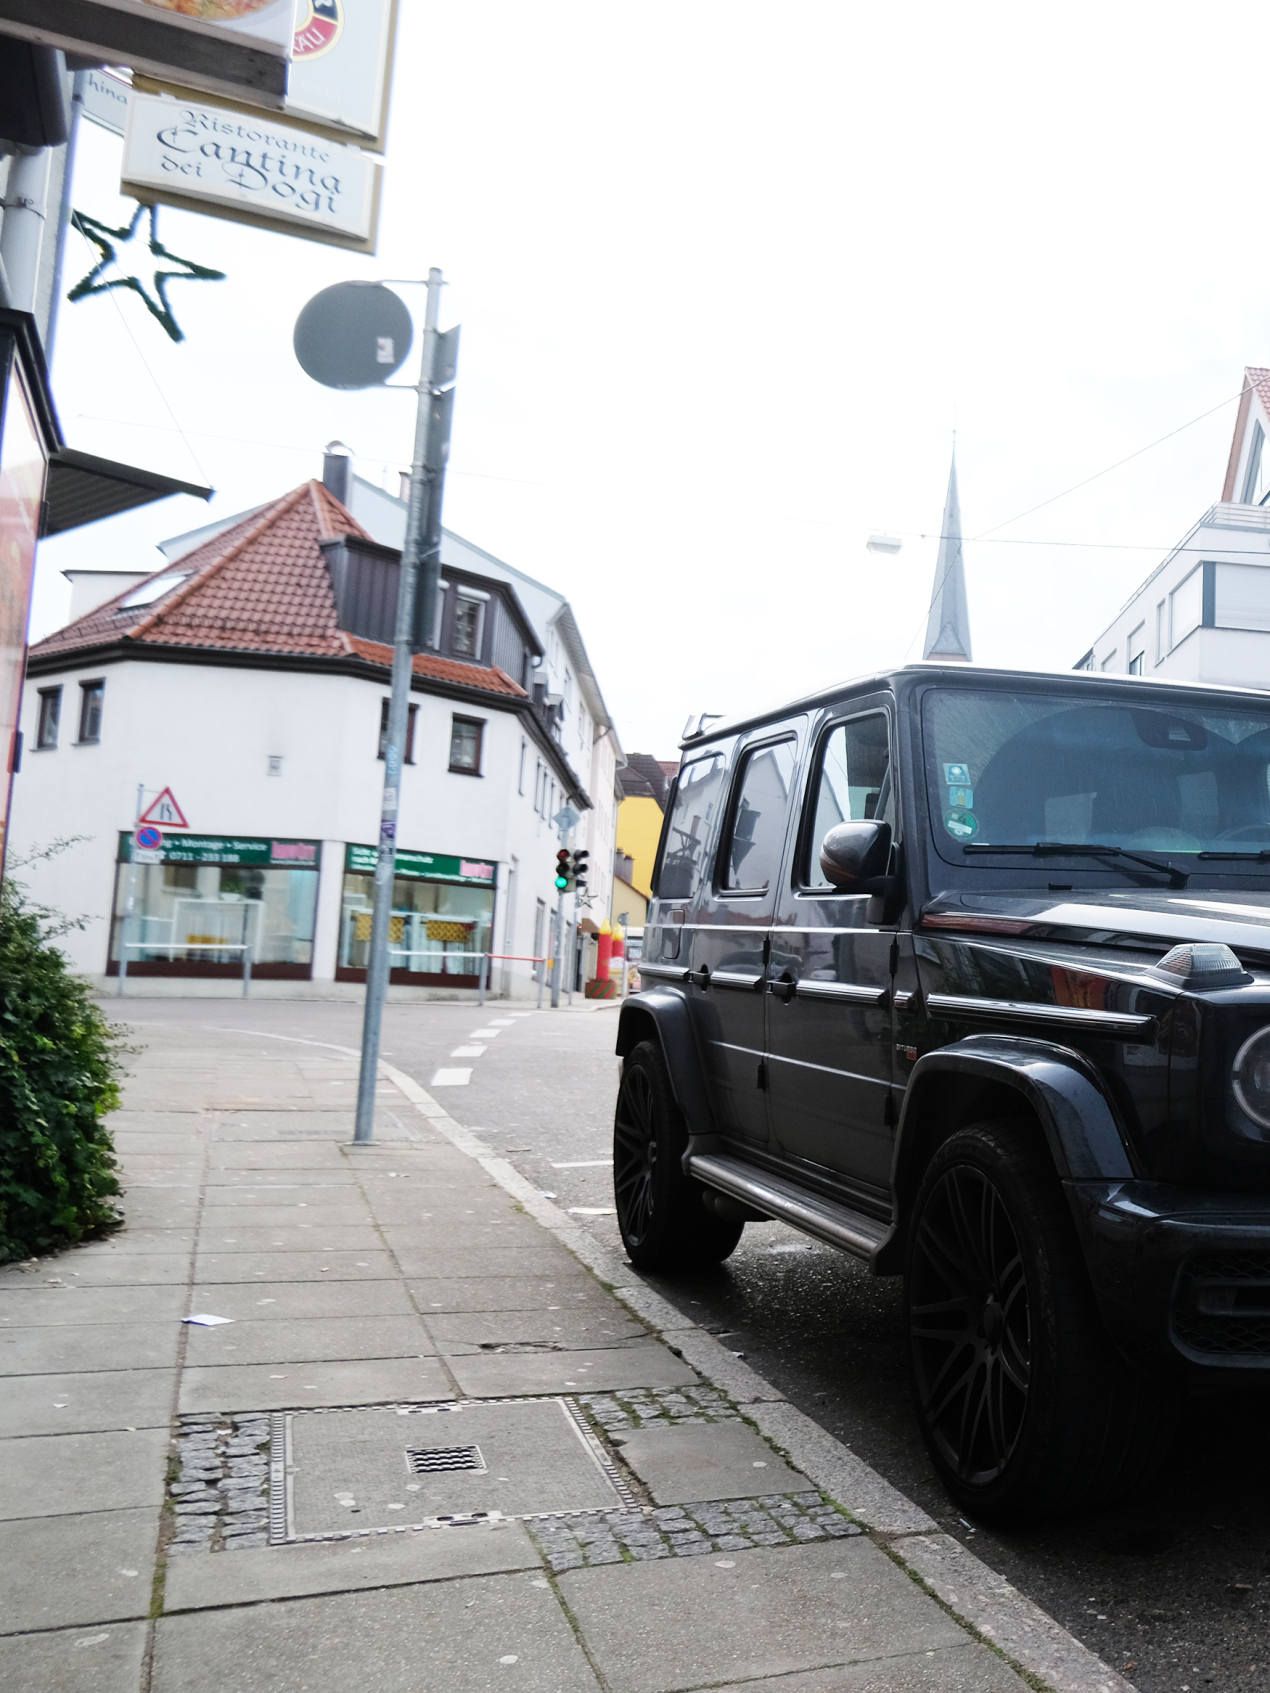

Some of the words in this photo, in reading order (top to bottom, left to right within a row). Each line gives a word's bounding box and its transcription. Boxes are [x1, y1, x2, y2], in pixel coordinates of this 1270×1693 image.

[87, 72, 128, 105] hina
[156, 125, 342, 195] Cantina
[180, 109, 331, 164] Ristorante
[160, 154, 203, 178] dei
[220, 160, 337, 213] Dogi
